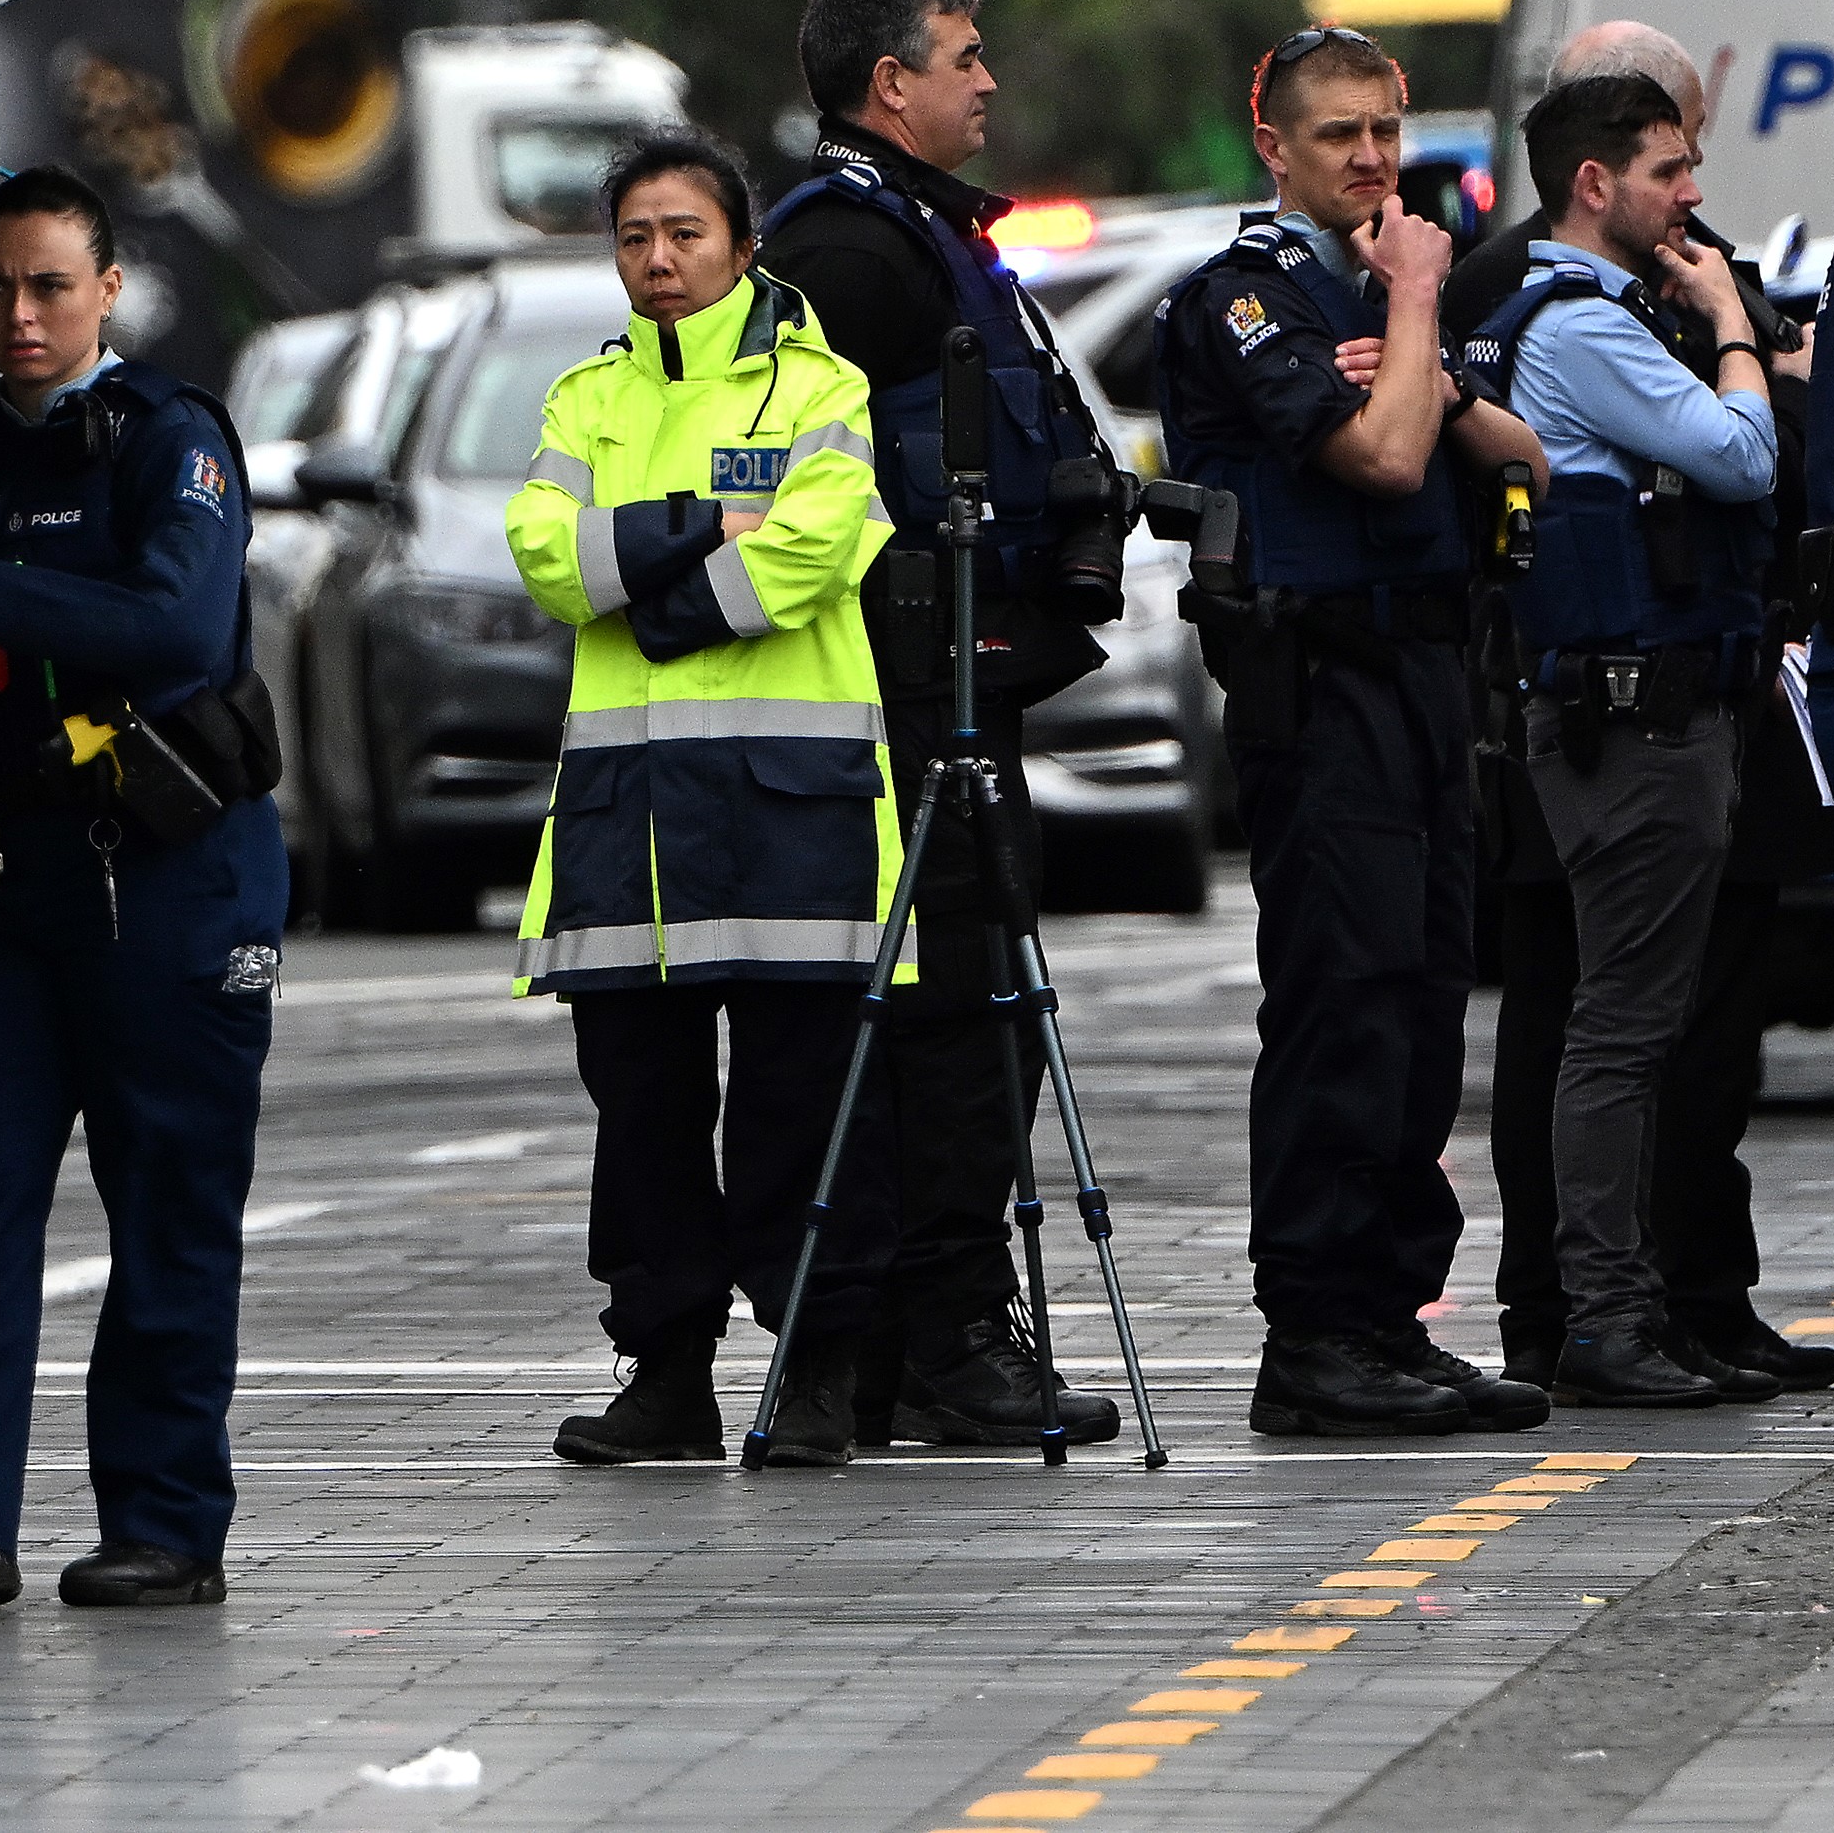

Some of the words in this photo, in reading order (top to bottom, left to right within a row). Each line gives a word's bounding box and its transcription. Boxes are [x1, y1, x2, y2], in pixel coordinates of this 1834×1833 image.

[1238, 321, 1281, 357] POLICE
[30, 509, 83, 526] POLICE
[180, 487, 225, 520] POLICE
